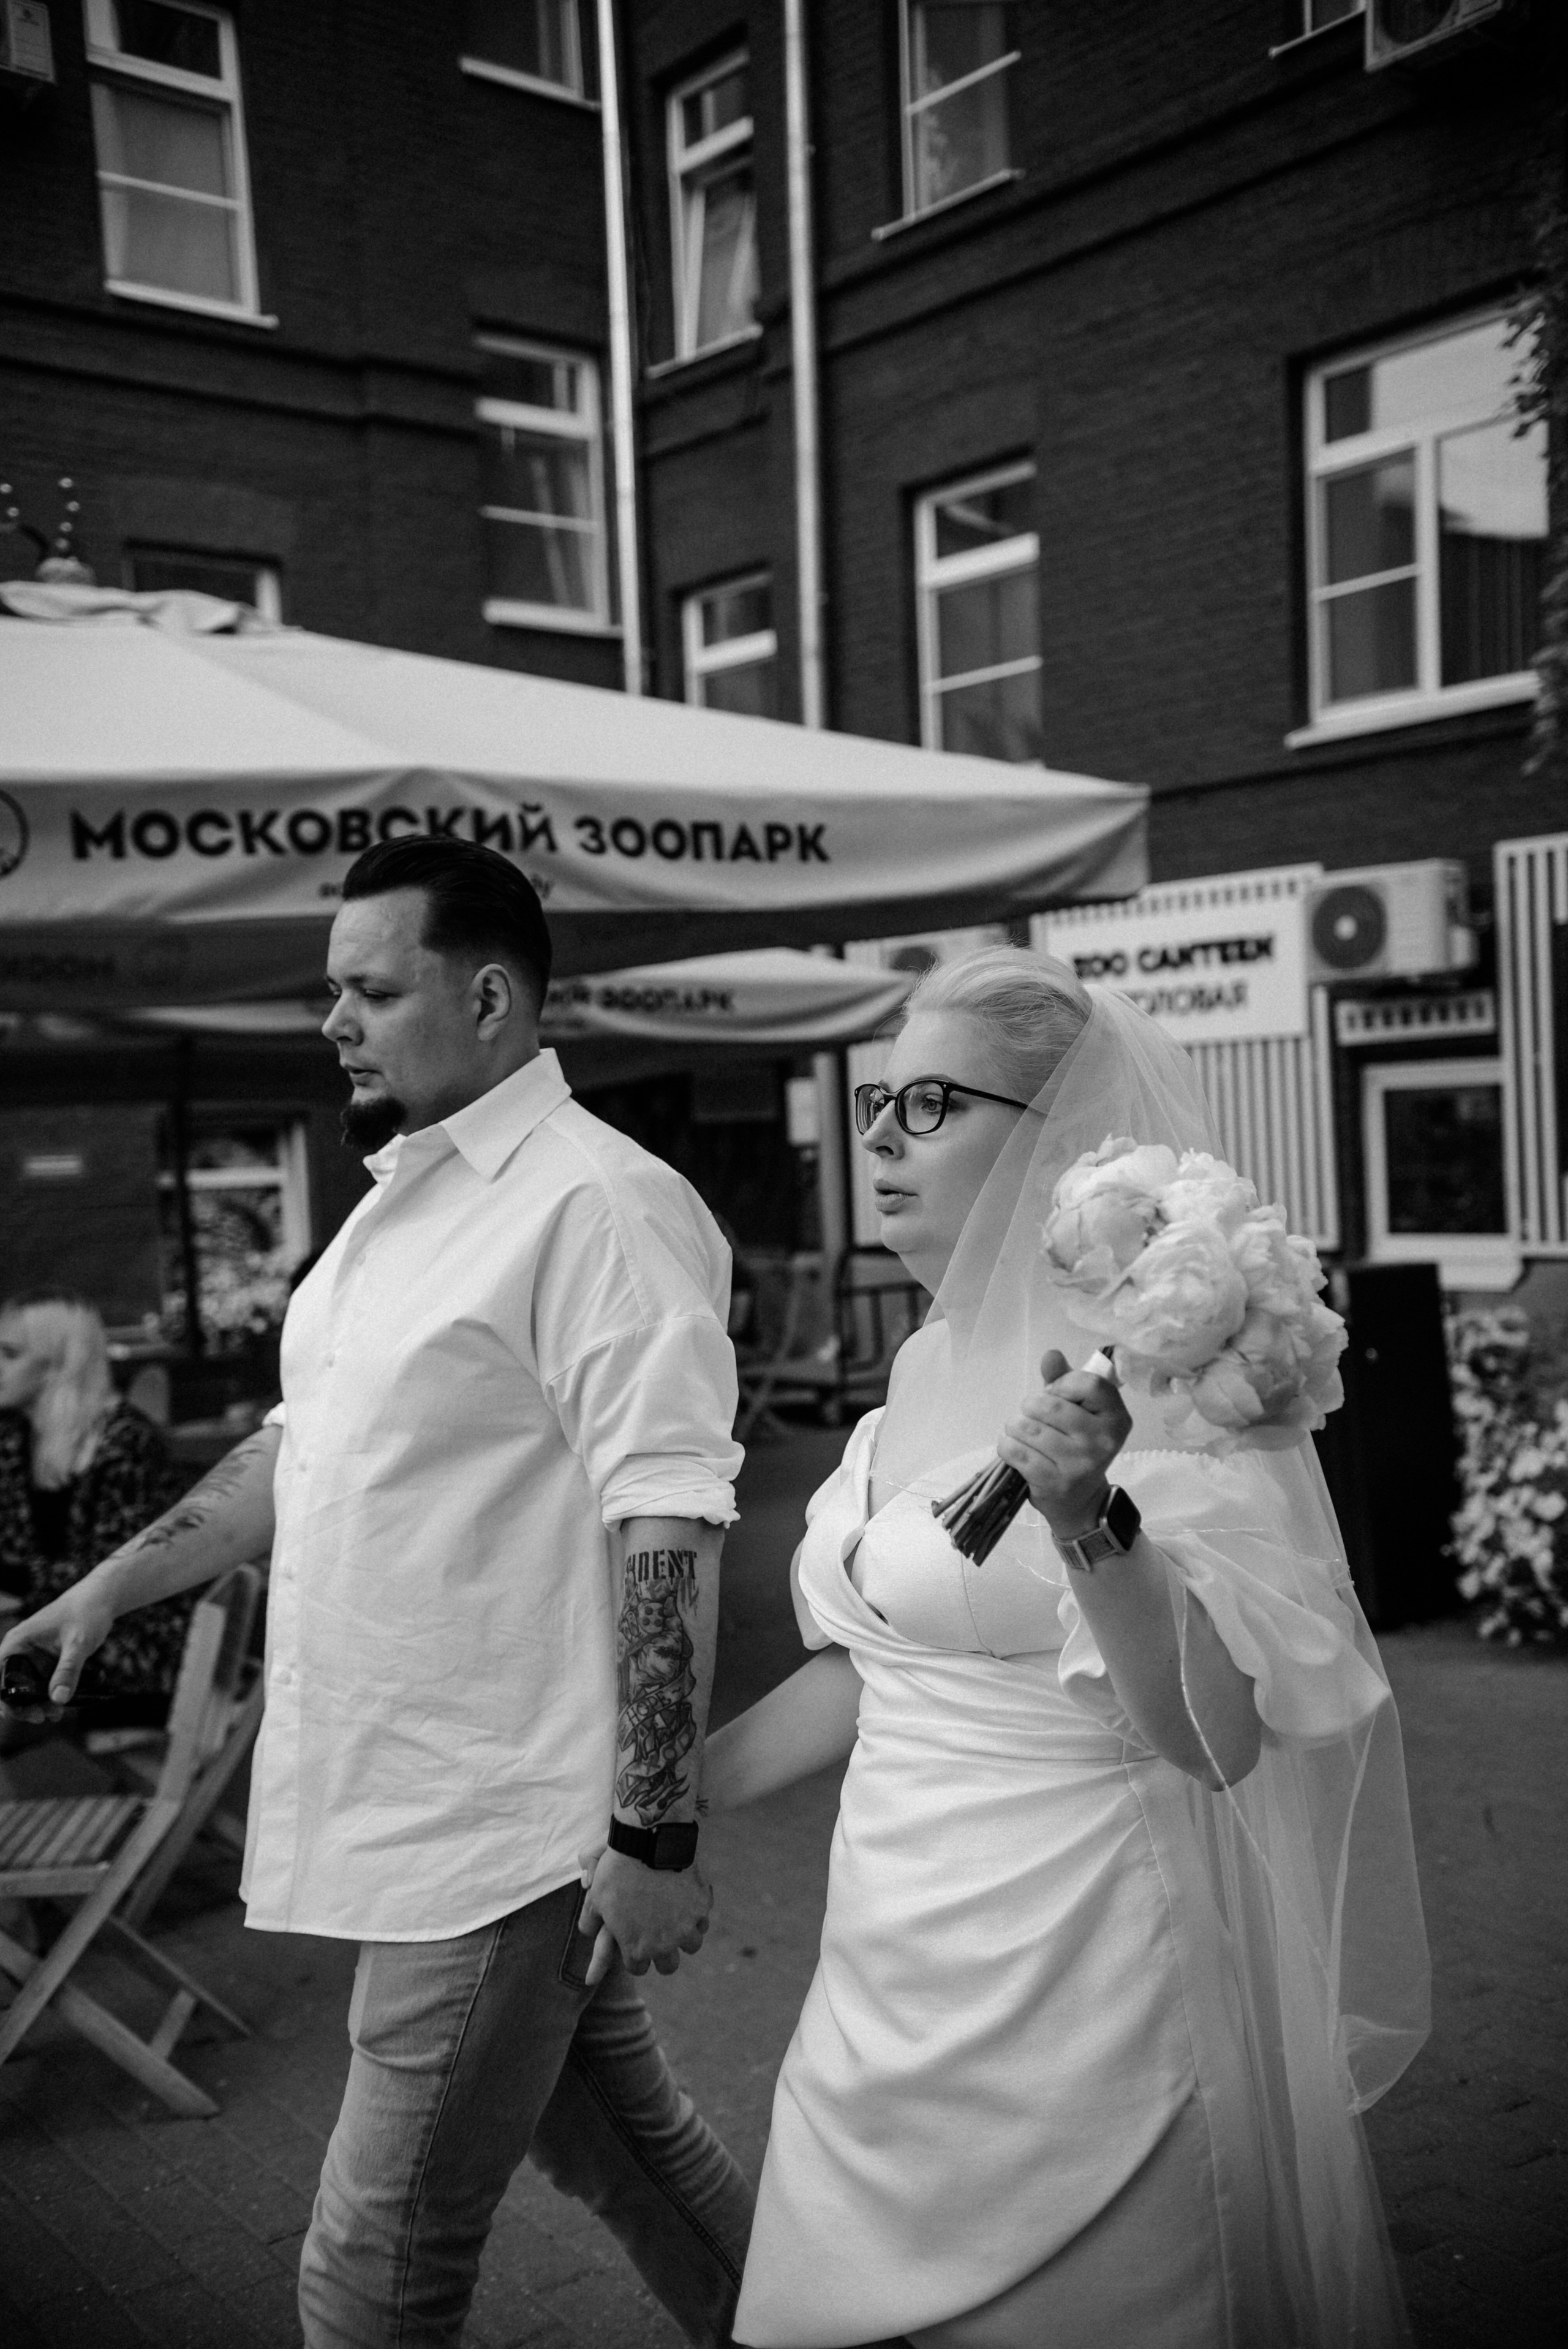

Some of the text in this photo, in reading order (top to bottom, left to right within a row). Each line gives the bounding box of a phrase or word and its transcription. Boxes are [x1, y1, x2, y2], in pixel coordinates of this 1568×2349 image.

[574, 817, 830, 861] ЗООПАРК
[1137, 936, 1272, 972] CANTEEN
[626, 1690, 672, 1728] HOPE
